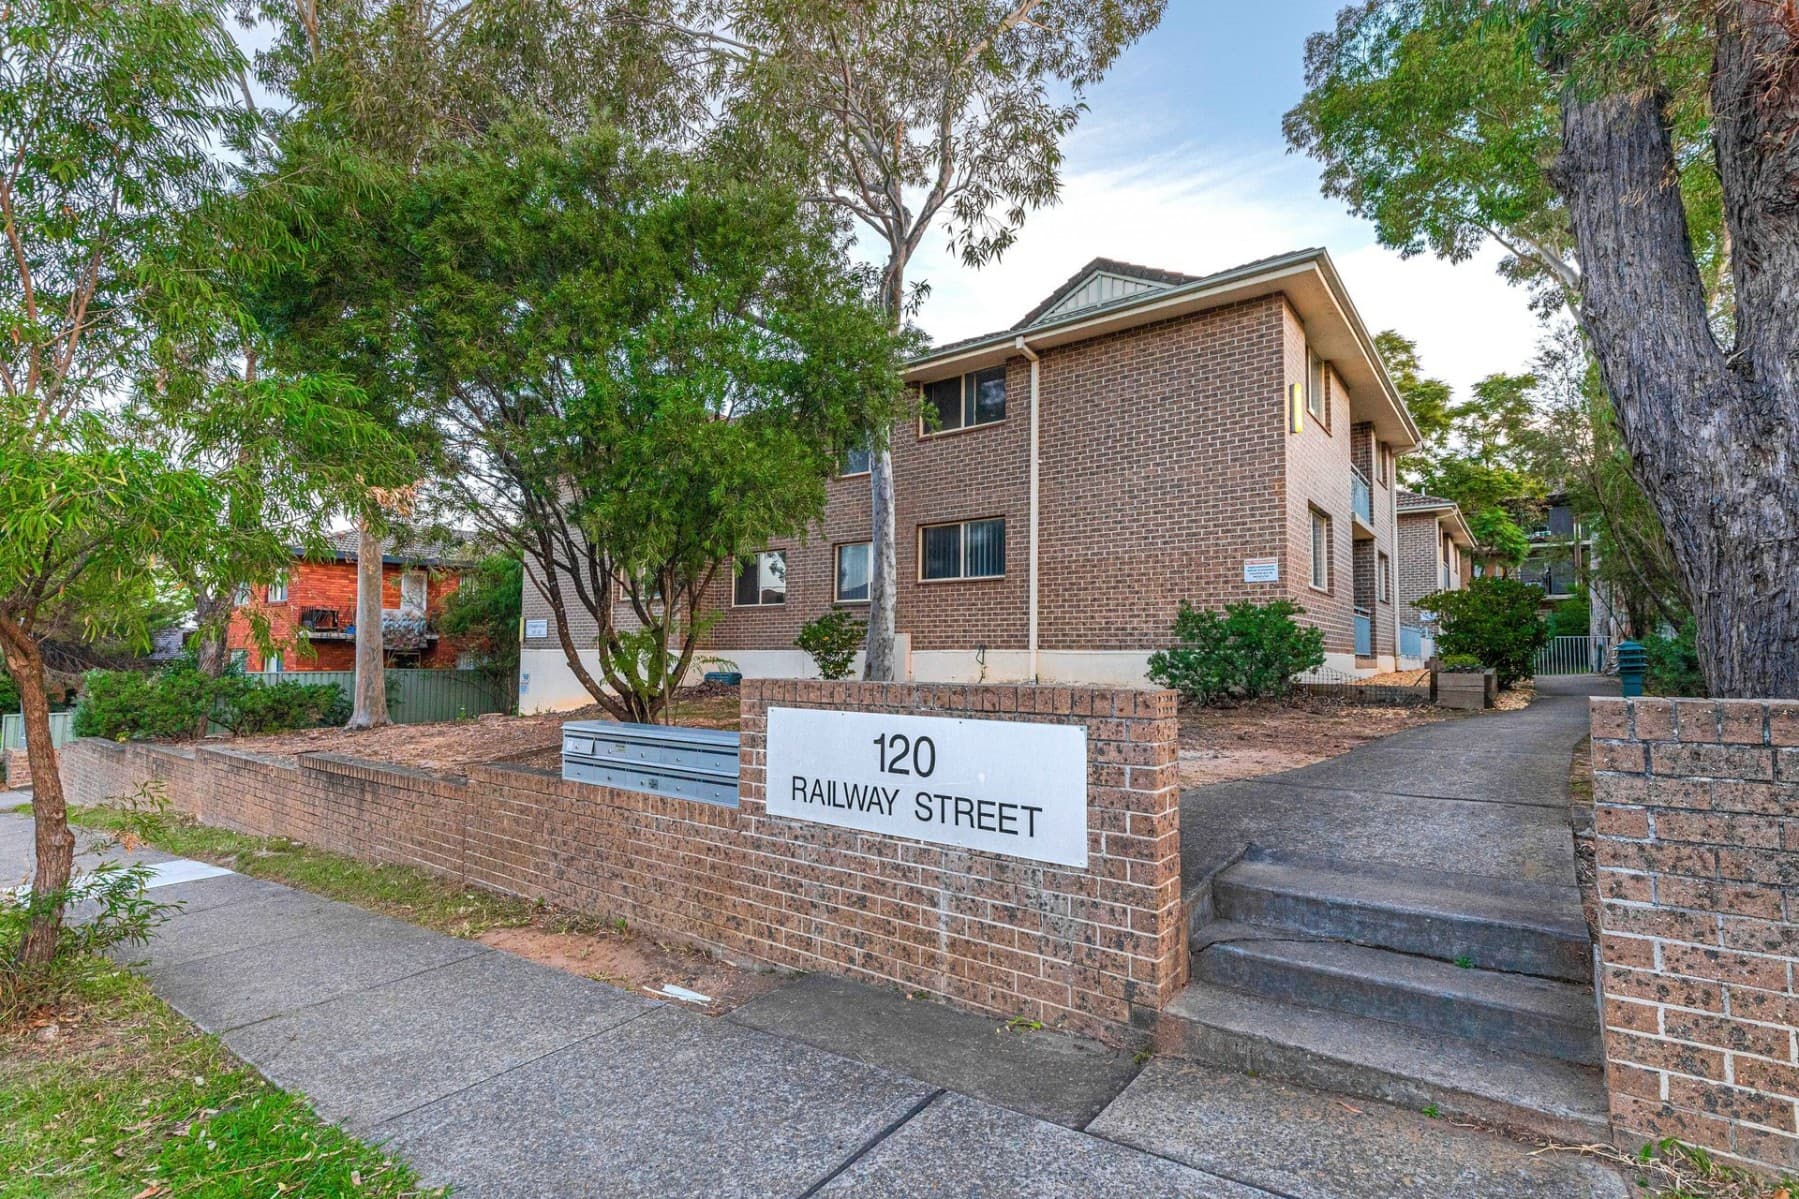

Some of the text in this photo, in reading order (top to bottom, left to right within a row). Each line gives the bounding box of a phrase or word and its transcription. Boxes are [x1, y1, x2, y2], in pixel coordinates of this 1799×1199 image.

[873, 733, 936, 778] 120
[792, 776, 1043, 838] RAILWAY STREET
